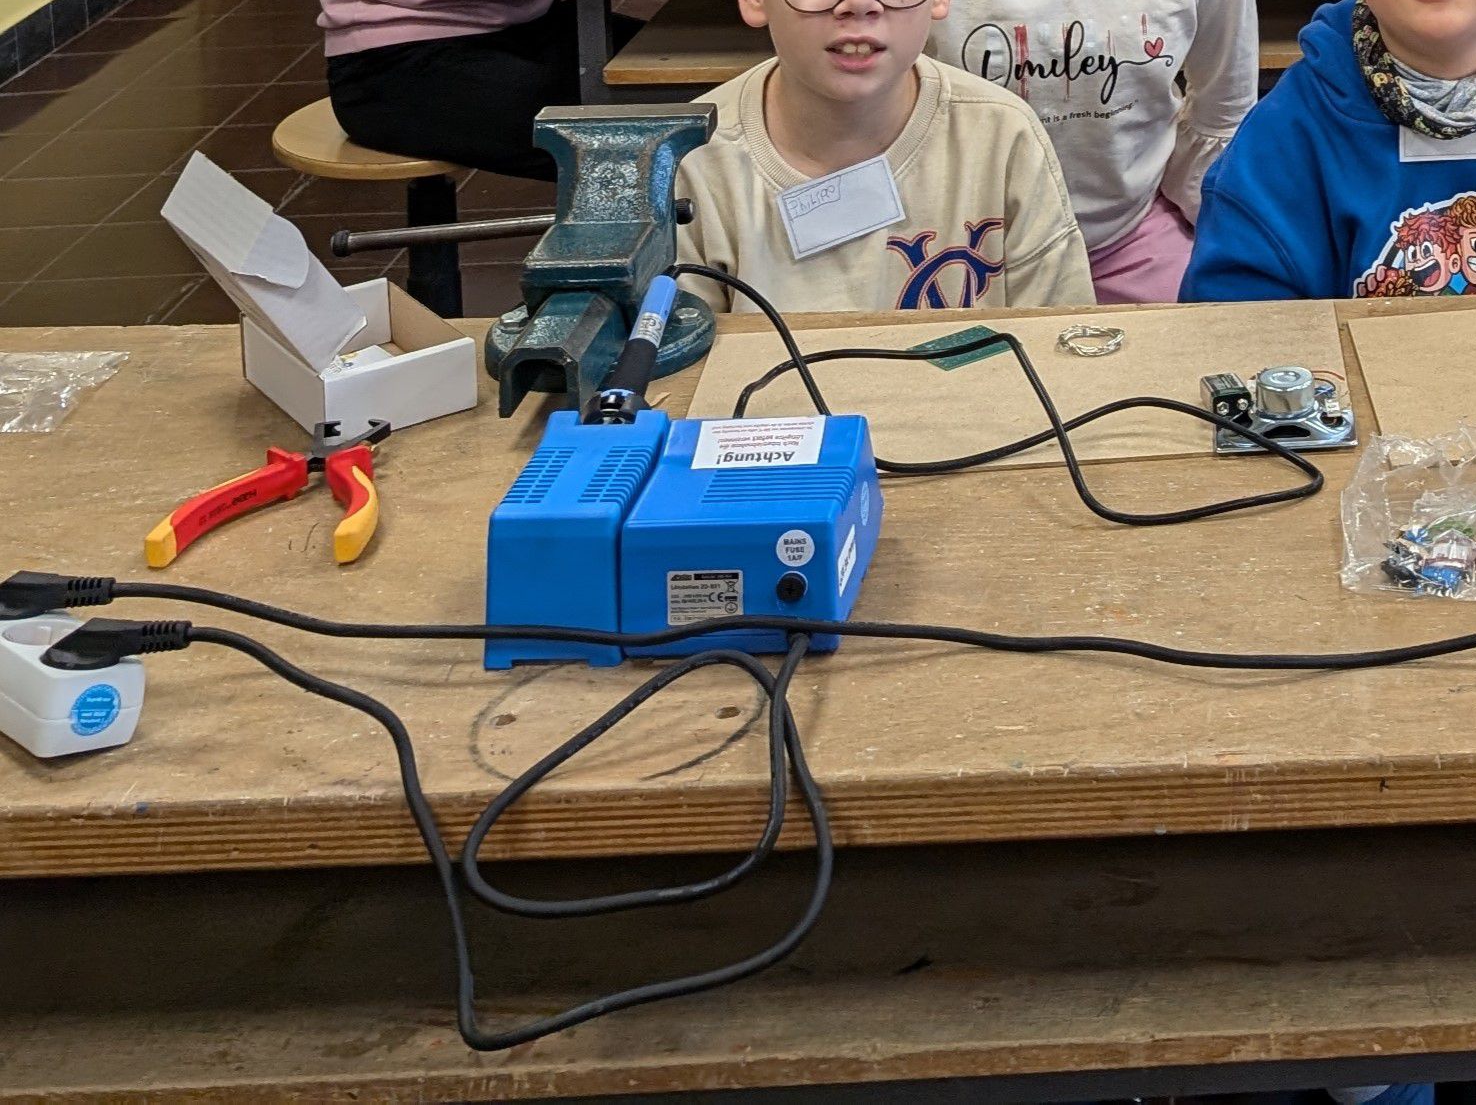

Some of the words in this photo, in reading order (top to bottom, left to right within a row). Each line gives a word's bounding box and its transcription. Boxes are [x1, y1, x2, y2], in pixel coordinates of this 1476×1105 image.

[1053, 115, 1061, 123] is
[1069, 111, 1092, 120] fresh
[716, 450, 796, 465] Achtung!
[783, 537, 807, 546] MAINS
[785, 546, 805, 554] FUSE
